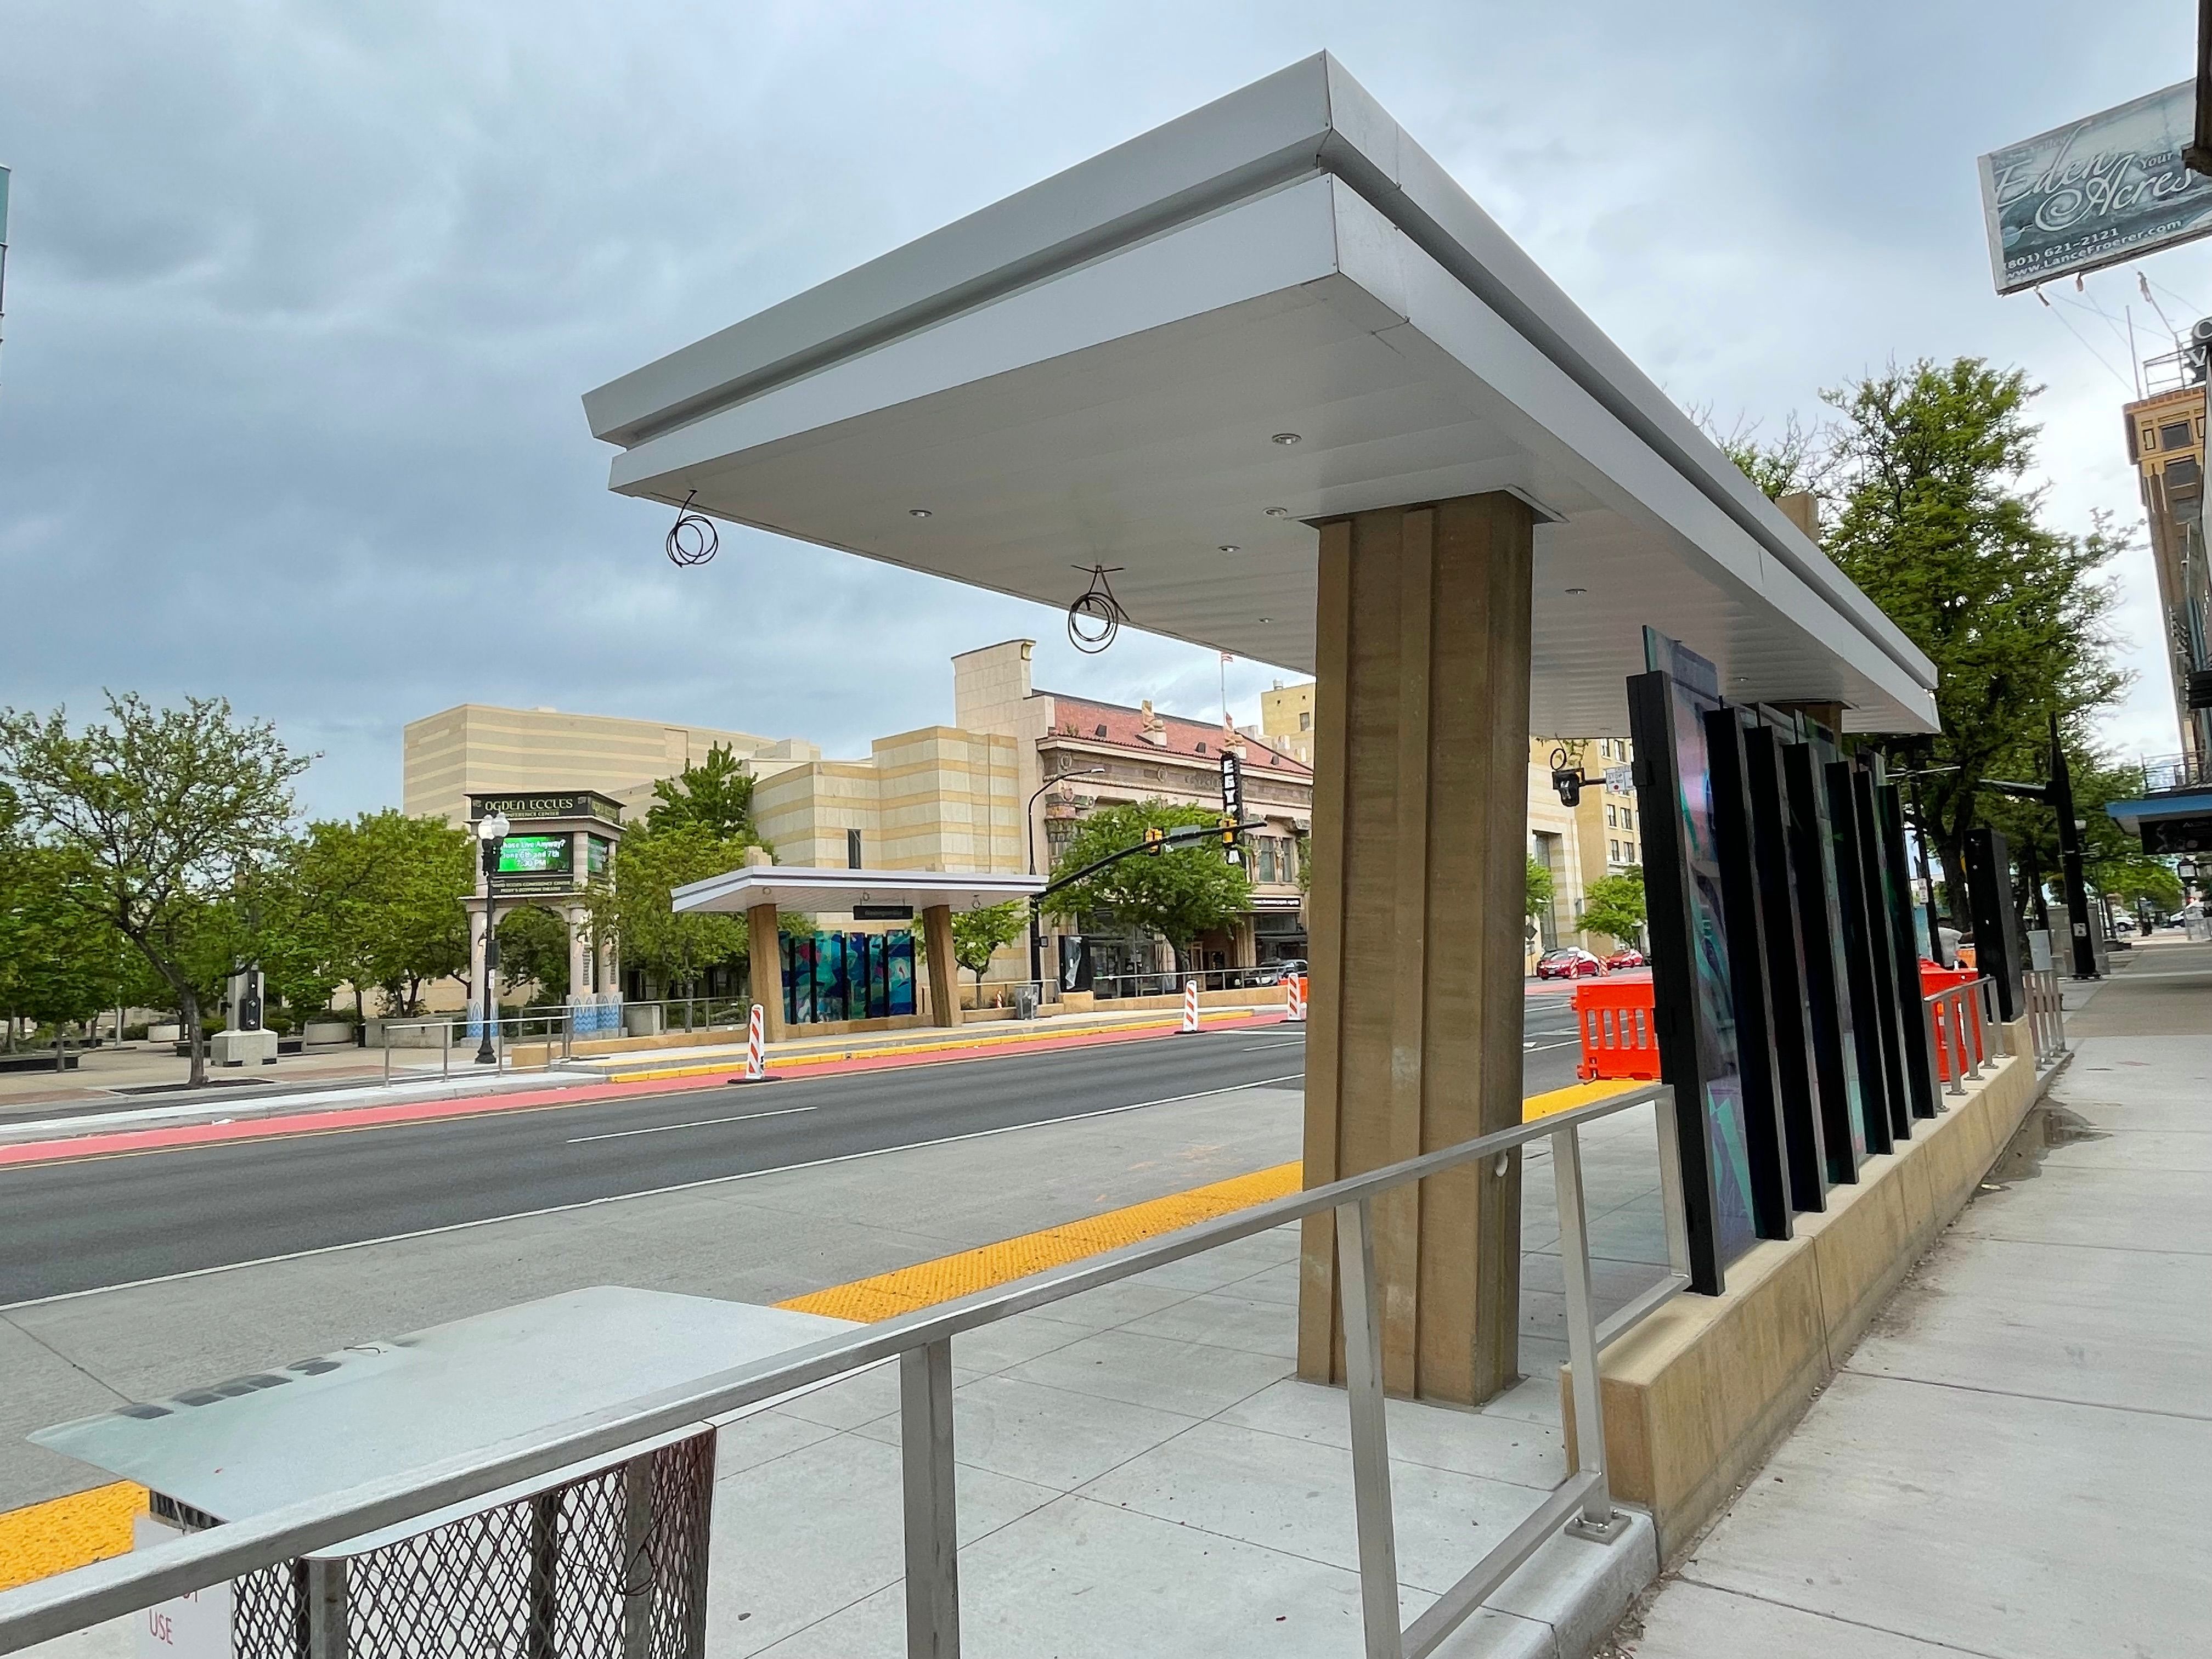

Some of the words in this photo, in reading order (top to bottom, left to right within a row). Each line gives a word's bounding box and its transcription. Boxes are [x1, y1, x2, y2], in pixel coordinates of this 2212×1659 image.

[1994, 121, 2118, 206] Eden
[2140, 151, 2173, 170] Your
[2035, 153, 2192, 232] Acres
[485, 800, 525, 812] OGDEN
[529, 799, 573, 810] ECCLES
[149, 1609, 173, 1645] USE
